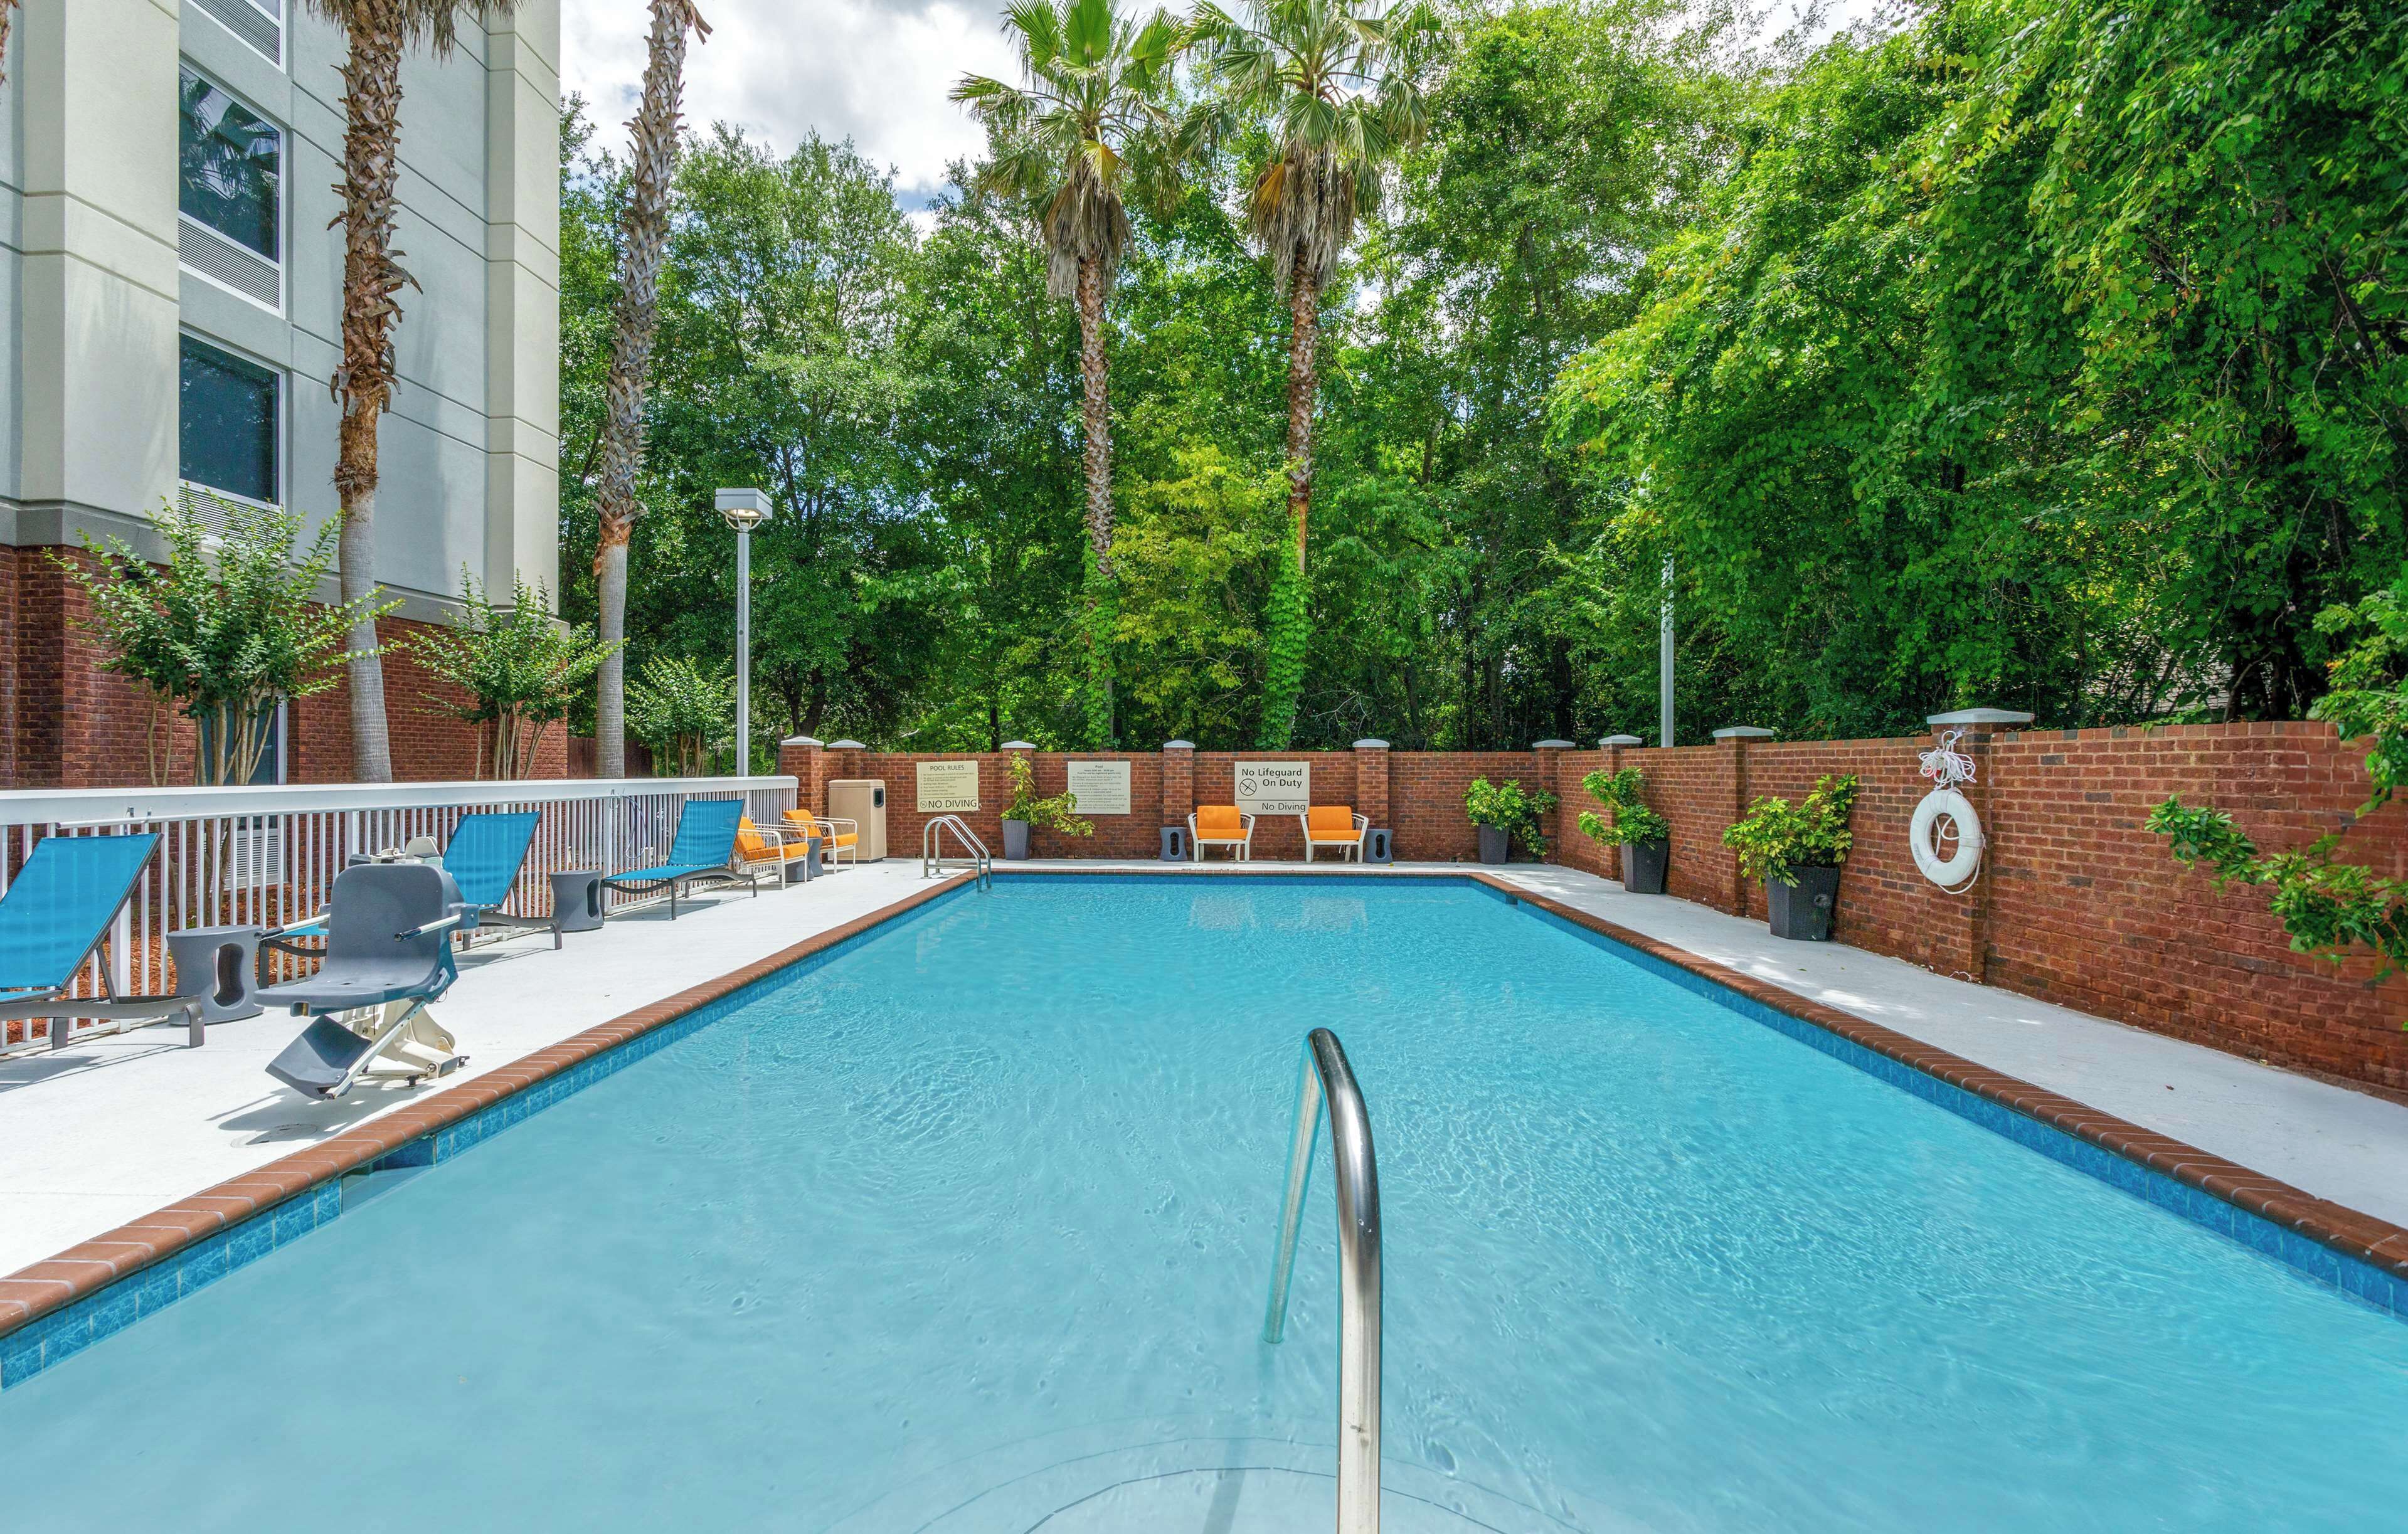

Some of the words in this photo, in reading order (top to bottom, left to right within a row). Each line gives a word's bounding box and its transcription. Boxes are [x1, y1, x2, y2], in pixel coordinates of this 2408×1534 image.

[1258, 768, 1302, 778] Lifeguard
[1280, 779, 1302, 788] Duty
[928, 800, 942, 808] NO
[945, 799, 977, 807] DIVING
[1278, 802, 1306, 812] Diving
